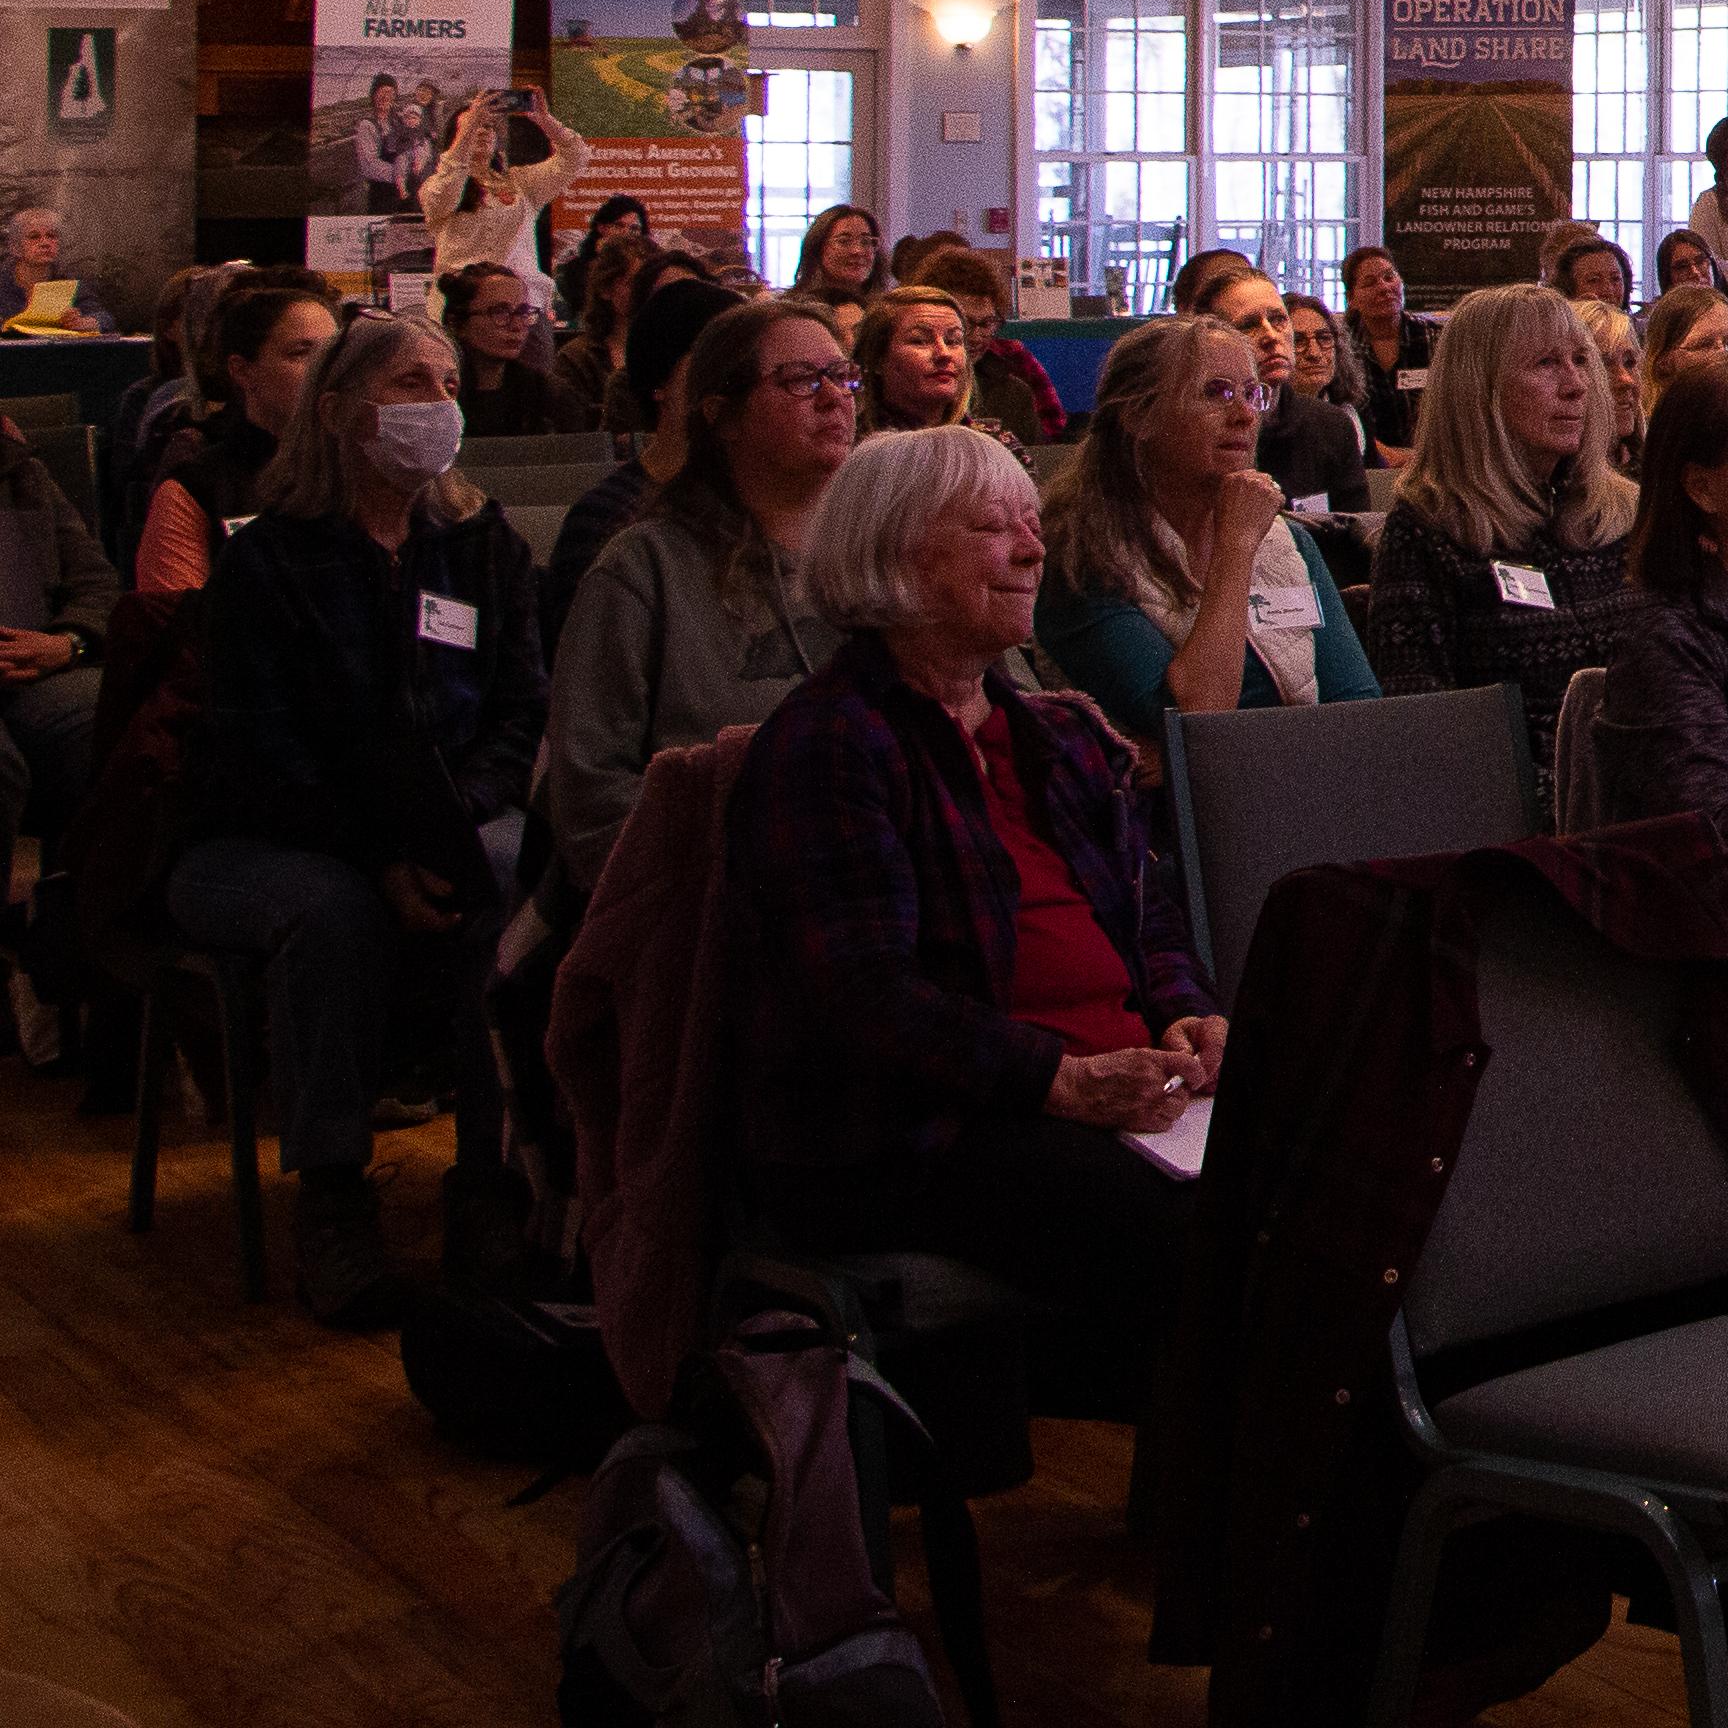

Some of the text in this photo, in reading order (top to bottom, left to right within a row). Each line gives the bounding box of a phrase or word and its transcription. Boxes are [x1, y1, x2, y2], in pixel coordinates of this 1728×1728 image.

[363, 17, 467, 39] FARMERS
[1391, 36, 1565, 68] LAND SHARE
[648, 144, 723, 160] AMERICA'S
[668, 162, 737, 178] GROWING
[1421, 187, 1534, 199] NEW HAMPSHIRE
[1419, 204, 1536, 216] FISH AND GAME'S
[1396, 221, 1484, 233] LANDOWNER
[1443, 238, 1512, 250] PROGRAM
